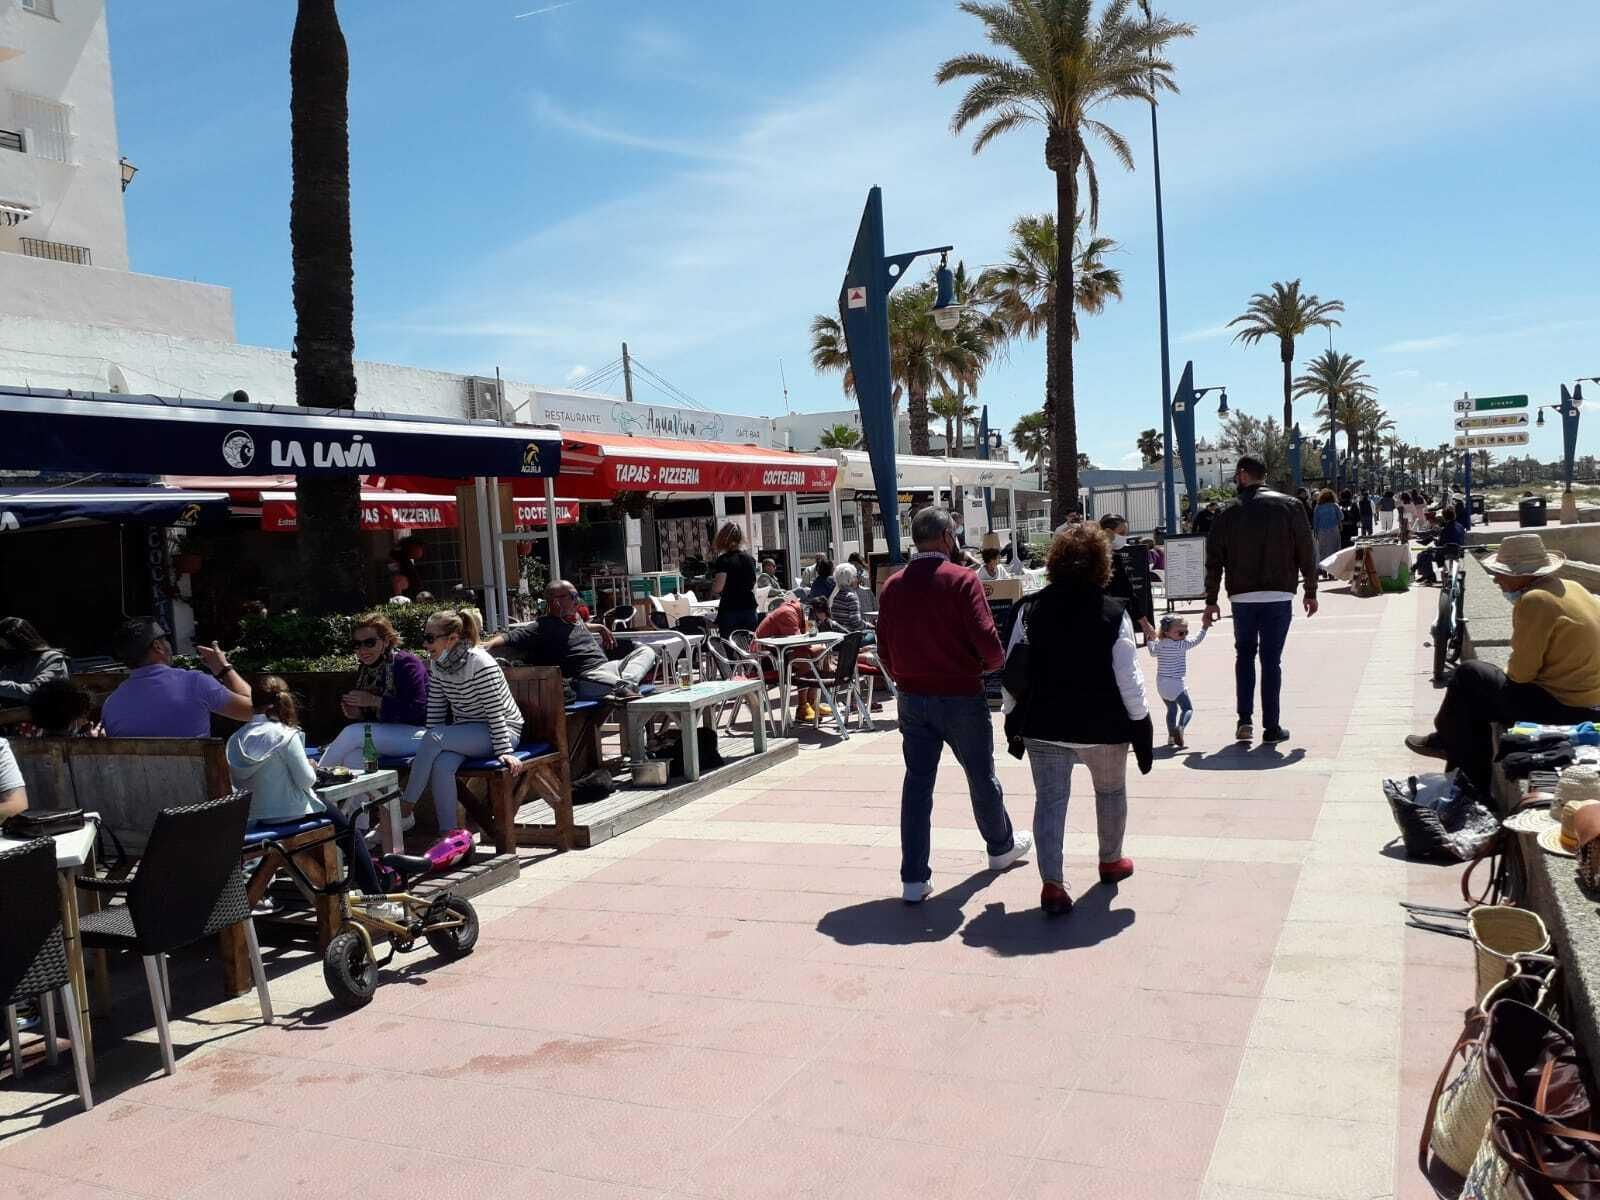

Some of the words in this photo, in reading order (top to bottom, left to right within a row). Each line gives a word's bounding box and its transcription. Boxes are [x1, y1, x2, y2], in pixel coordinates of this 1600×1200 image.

[1457, 401, 1472, 411] B2
[544, 409, 601, 424] RESTAURANTE
[271, 440, 307, 467] LA
[615, 463, 651, 483] TAPAS
[658, 466, 700, 485] PIZZERIA
[762, 470, 806, 486] COCTELERIA
[392, 508, 442, 523] PIZZERIA
[518, 506, 571, 520] COCTERIA
